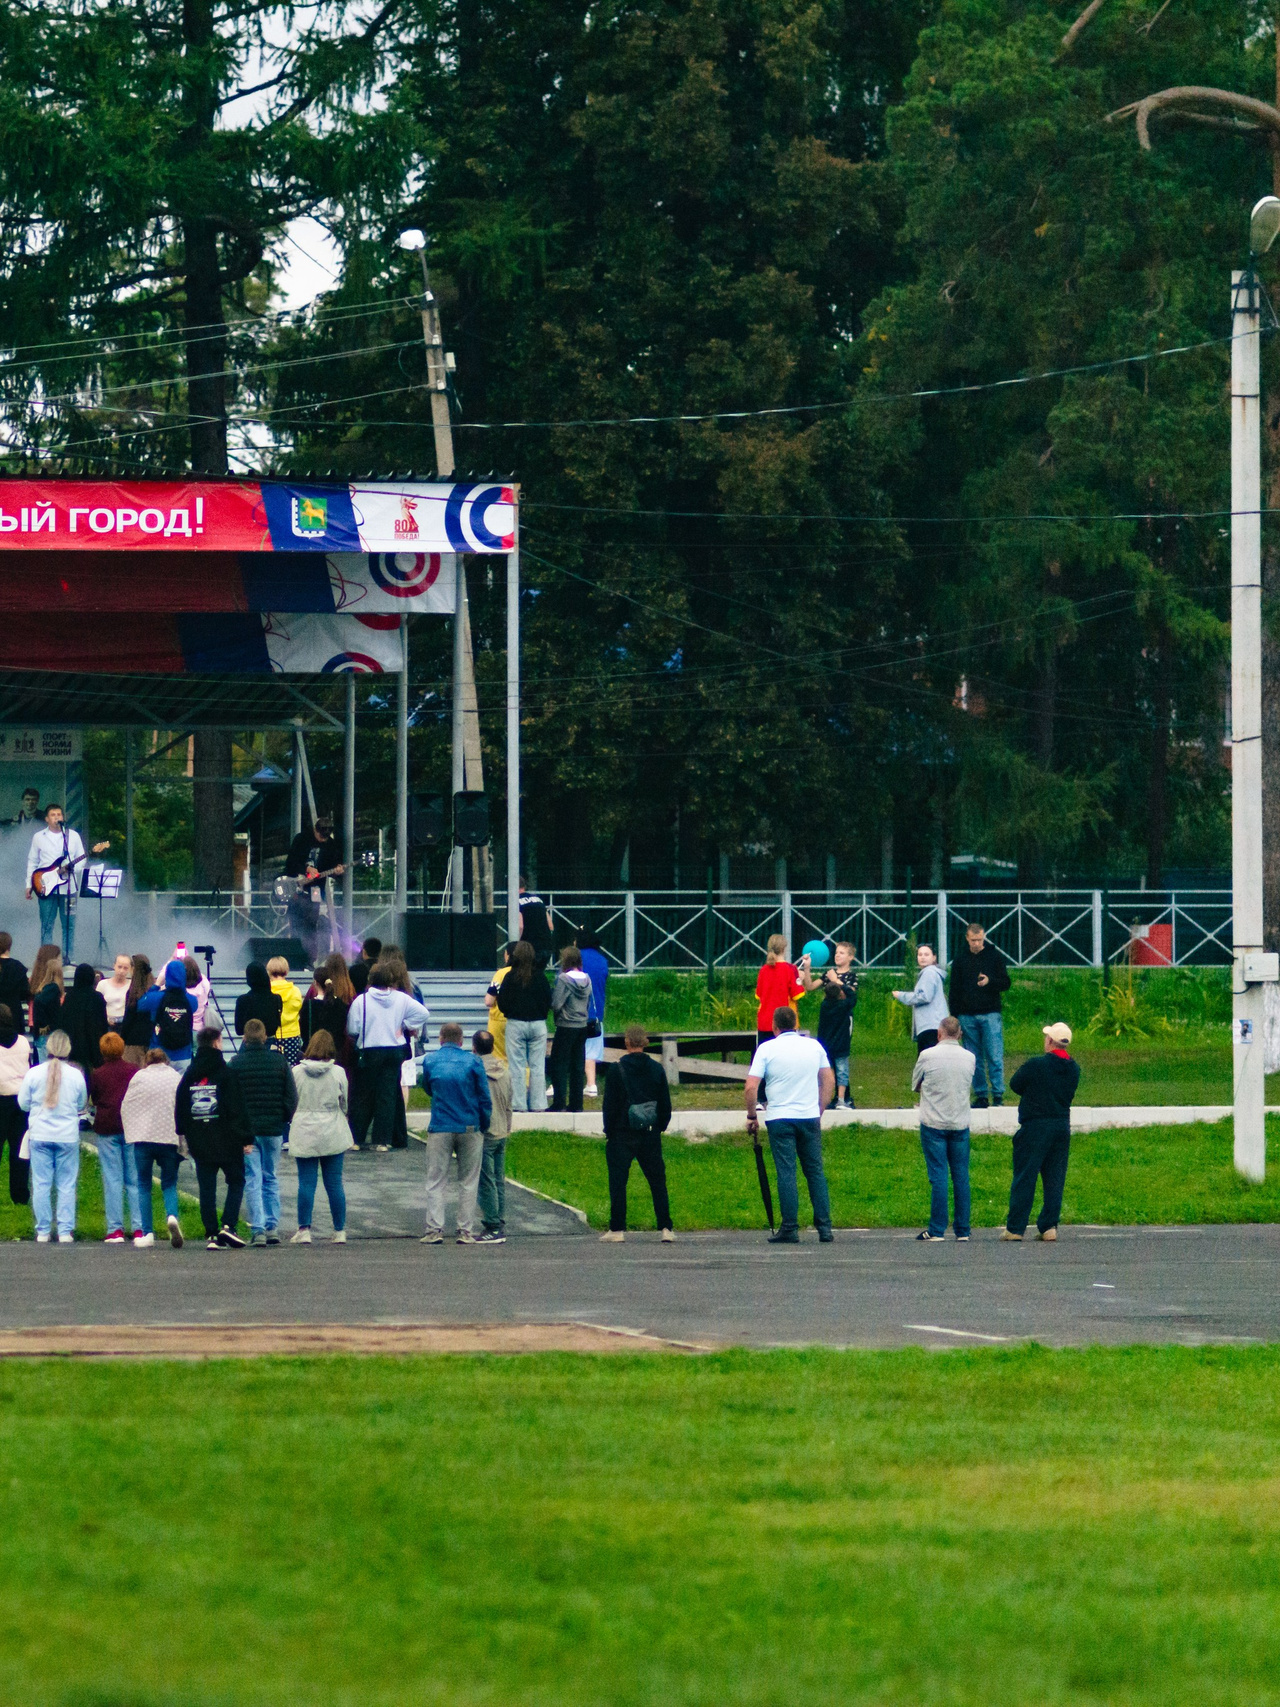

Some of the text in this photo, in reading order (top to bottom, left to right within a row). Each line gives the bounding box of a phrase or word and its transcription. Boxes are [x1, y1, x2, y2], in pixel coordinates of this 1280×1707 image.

[69, 497, 204, 538] ГОРОД!
[394, 519, 408, 532] 80
[42, 740, 72, 748] НОРМА
[42, 748, 72, 756] ЖИЗНИ
